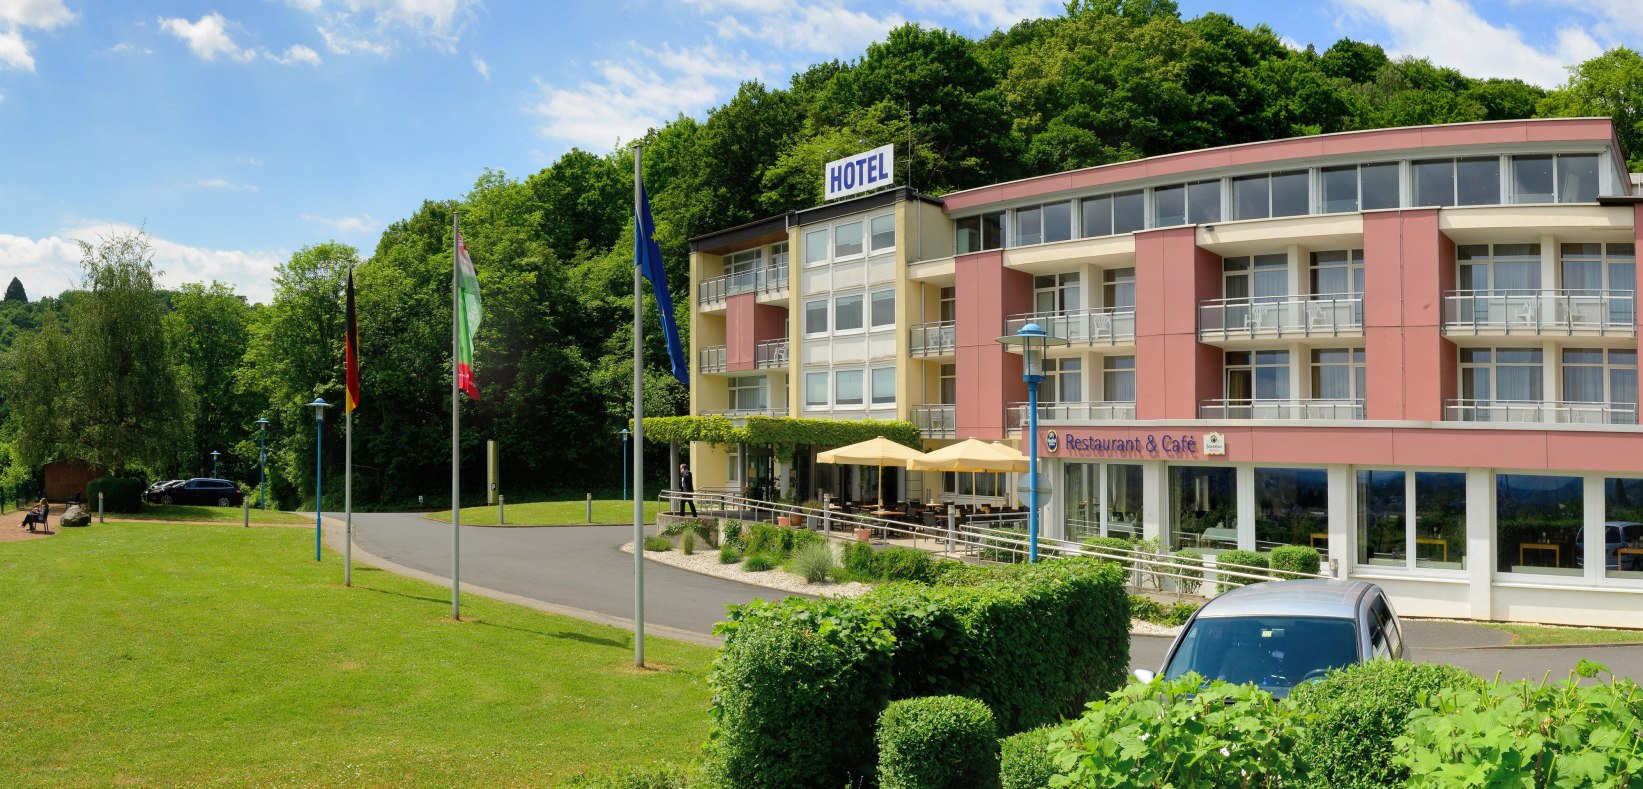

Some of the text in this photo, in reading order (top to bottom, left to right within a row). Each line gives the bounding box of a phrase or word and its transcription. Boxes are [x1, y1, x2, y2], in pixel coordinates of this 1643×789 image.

[831, 152, 888, 193] HOTEL
[1066, 433, 1140, 452] Restaurant
[1145, 434, 1157, 453] &
[1161, 434, 1196, 453] Café
